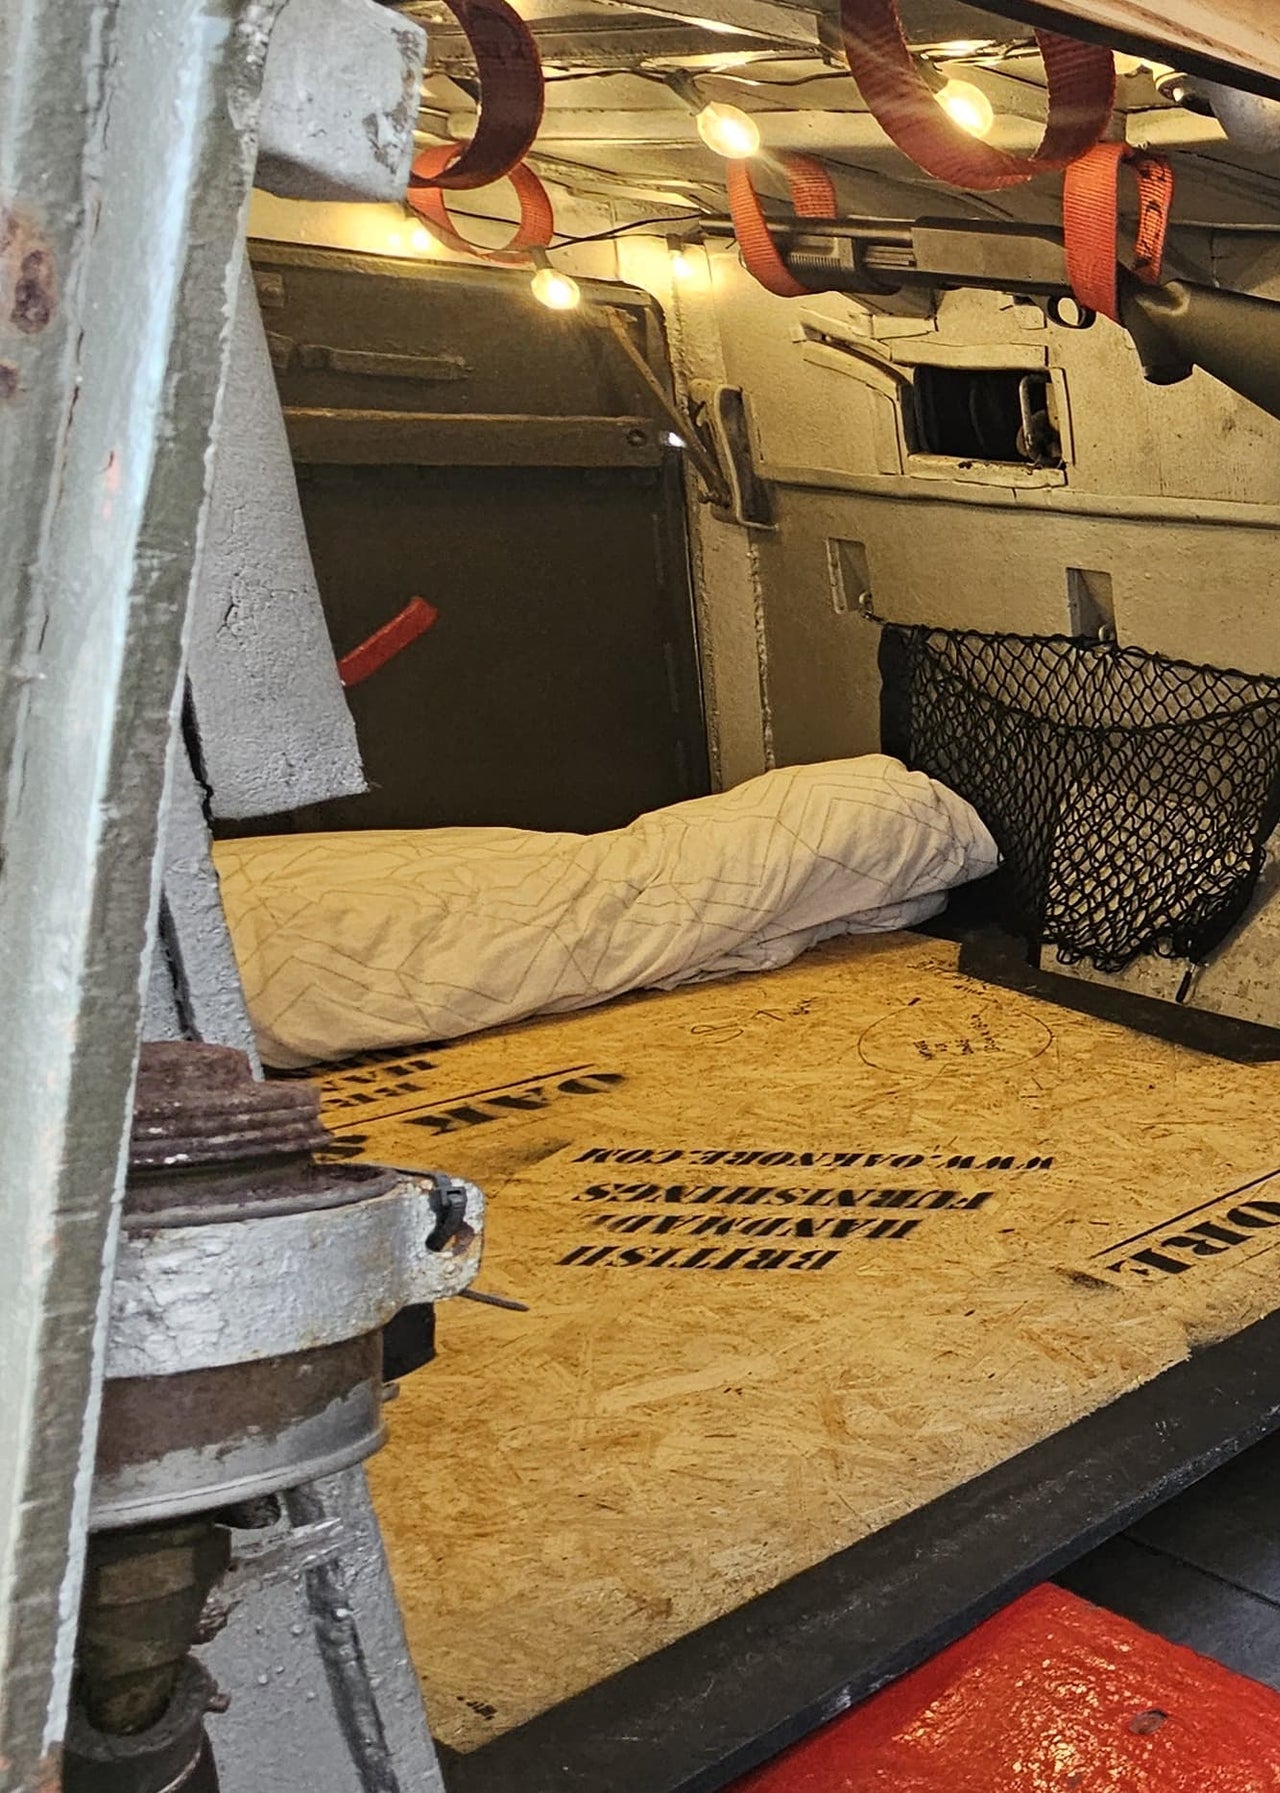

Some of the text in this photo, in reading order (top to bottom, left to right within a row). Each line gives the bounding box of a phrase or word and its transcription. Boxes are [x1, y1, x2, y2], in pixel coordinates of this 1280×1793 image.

[401, 1072, 627, 1137] OAK
[570, 1146, 1056, 1171] WWW.OAKNORE.COM
[571, 1181, 995, 1211] FURNISHINGS
[576, 1213, 923, 1240] HANDMADE
[554, 1245, 842, 1272] BRITISH
